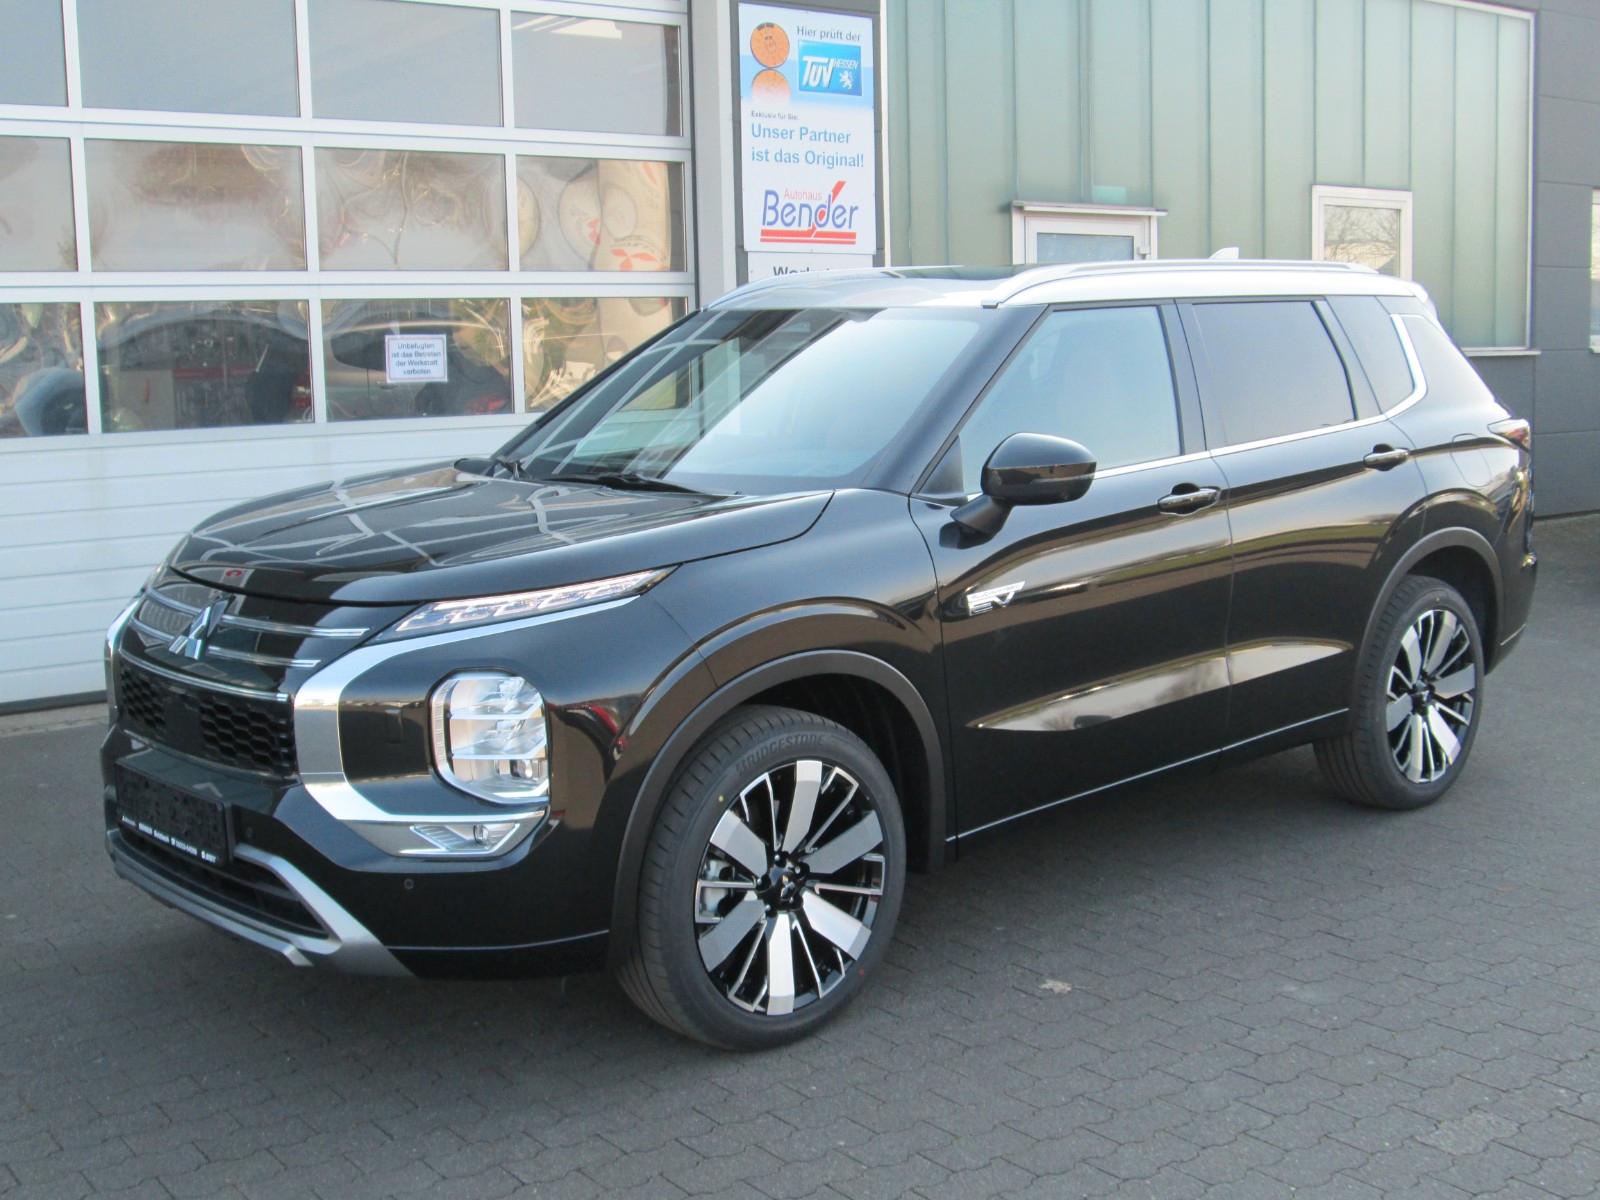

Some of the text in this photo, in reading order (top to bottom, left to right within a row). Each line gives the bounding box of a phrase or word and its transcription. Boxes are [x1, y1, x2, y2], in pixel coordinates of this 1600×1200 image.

[797, 26, 861, 41] Hier prüft der
[802, 56, 835, 88] TÜV
[751, 123, 851, 144] Unser Partner
[751, 147, 865, 169] ist das Original!
[783, 187, 823, 201] Autohaus
[762, 188, 859, 229] Bender
[735, 733, 826, 774] BRIDGESTONE
